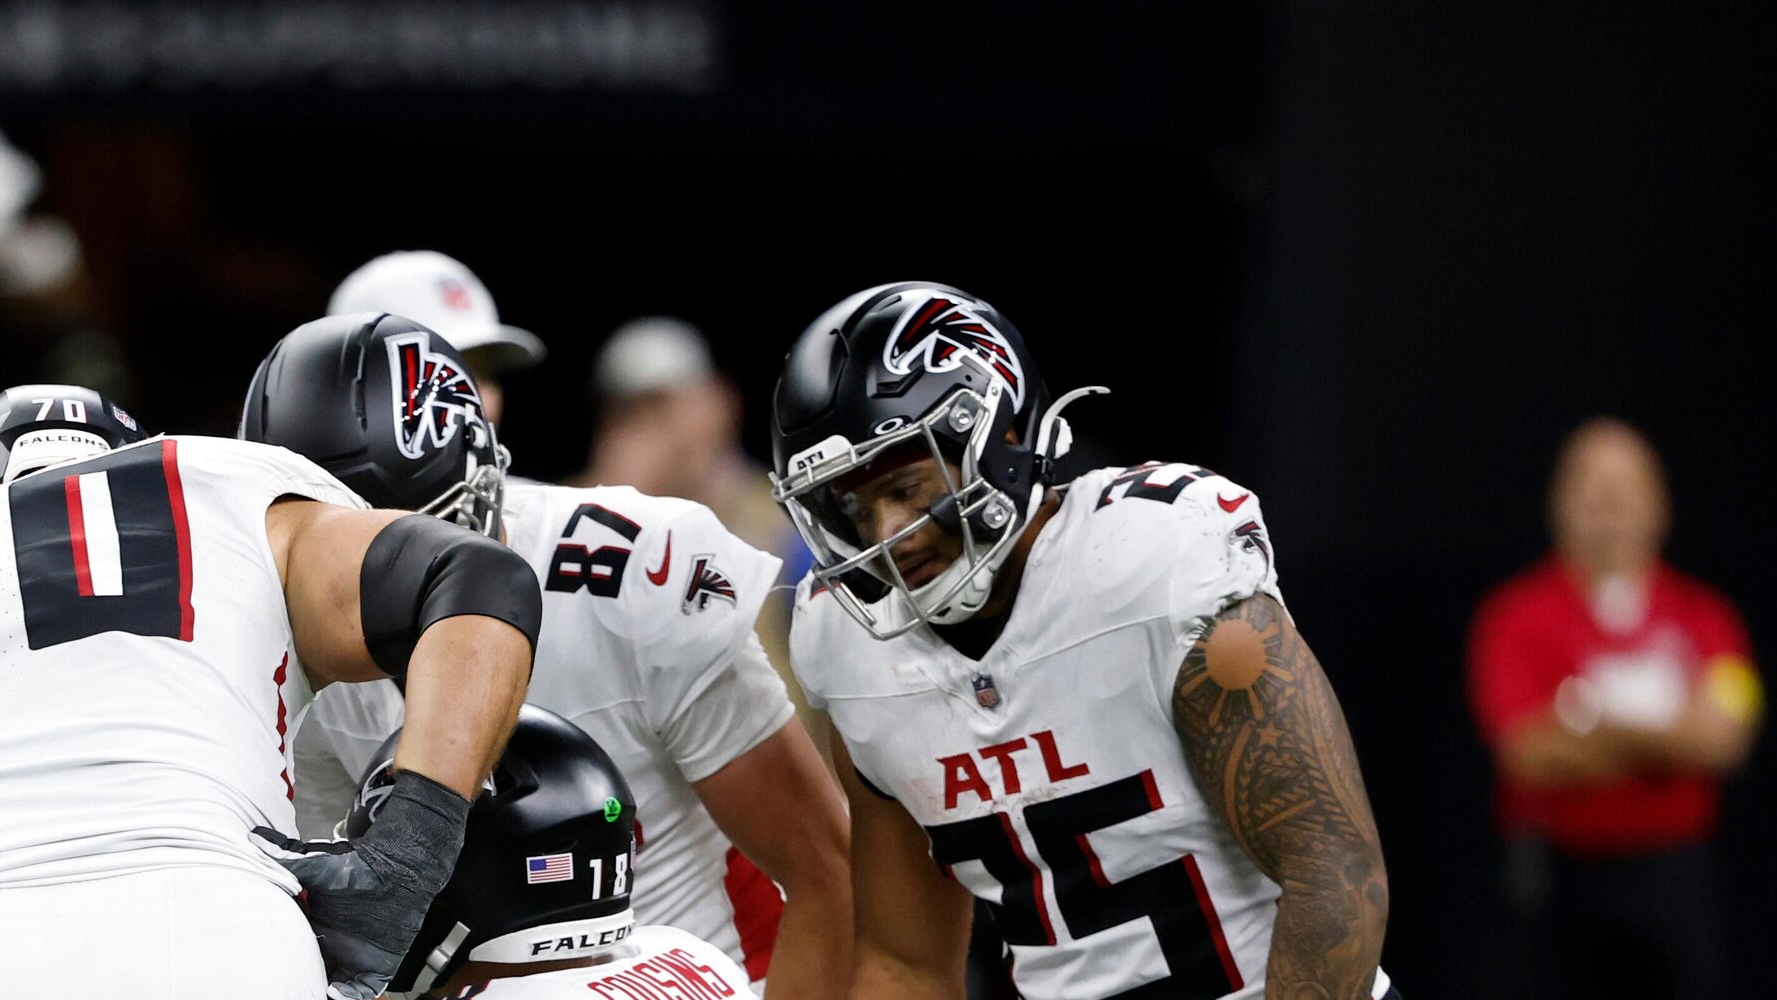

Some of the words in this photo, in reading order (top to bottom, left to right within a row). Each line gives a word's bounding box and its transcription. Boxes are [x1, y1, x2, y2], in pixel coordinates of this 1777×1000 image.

[31, 398, 88, 424] 70
[19, 435, 109, 451] FALCONS
[545, 503, 643, 599] 87
[936, 730, 1090, 810] ATL
[589, 852, 628, 900] 18
